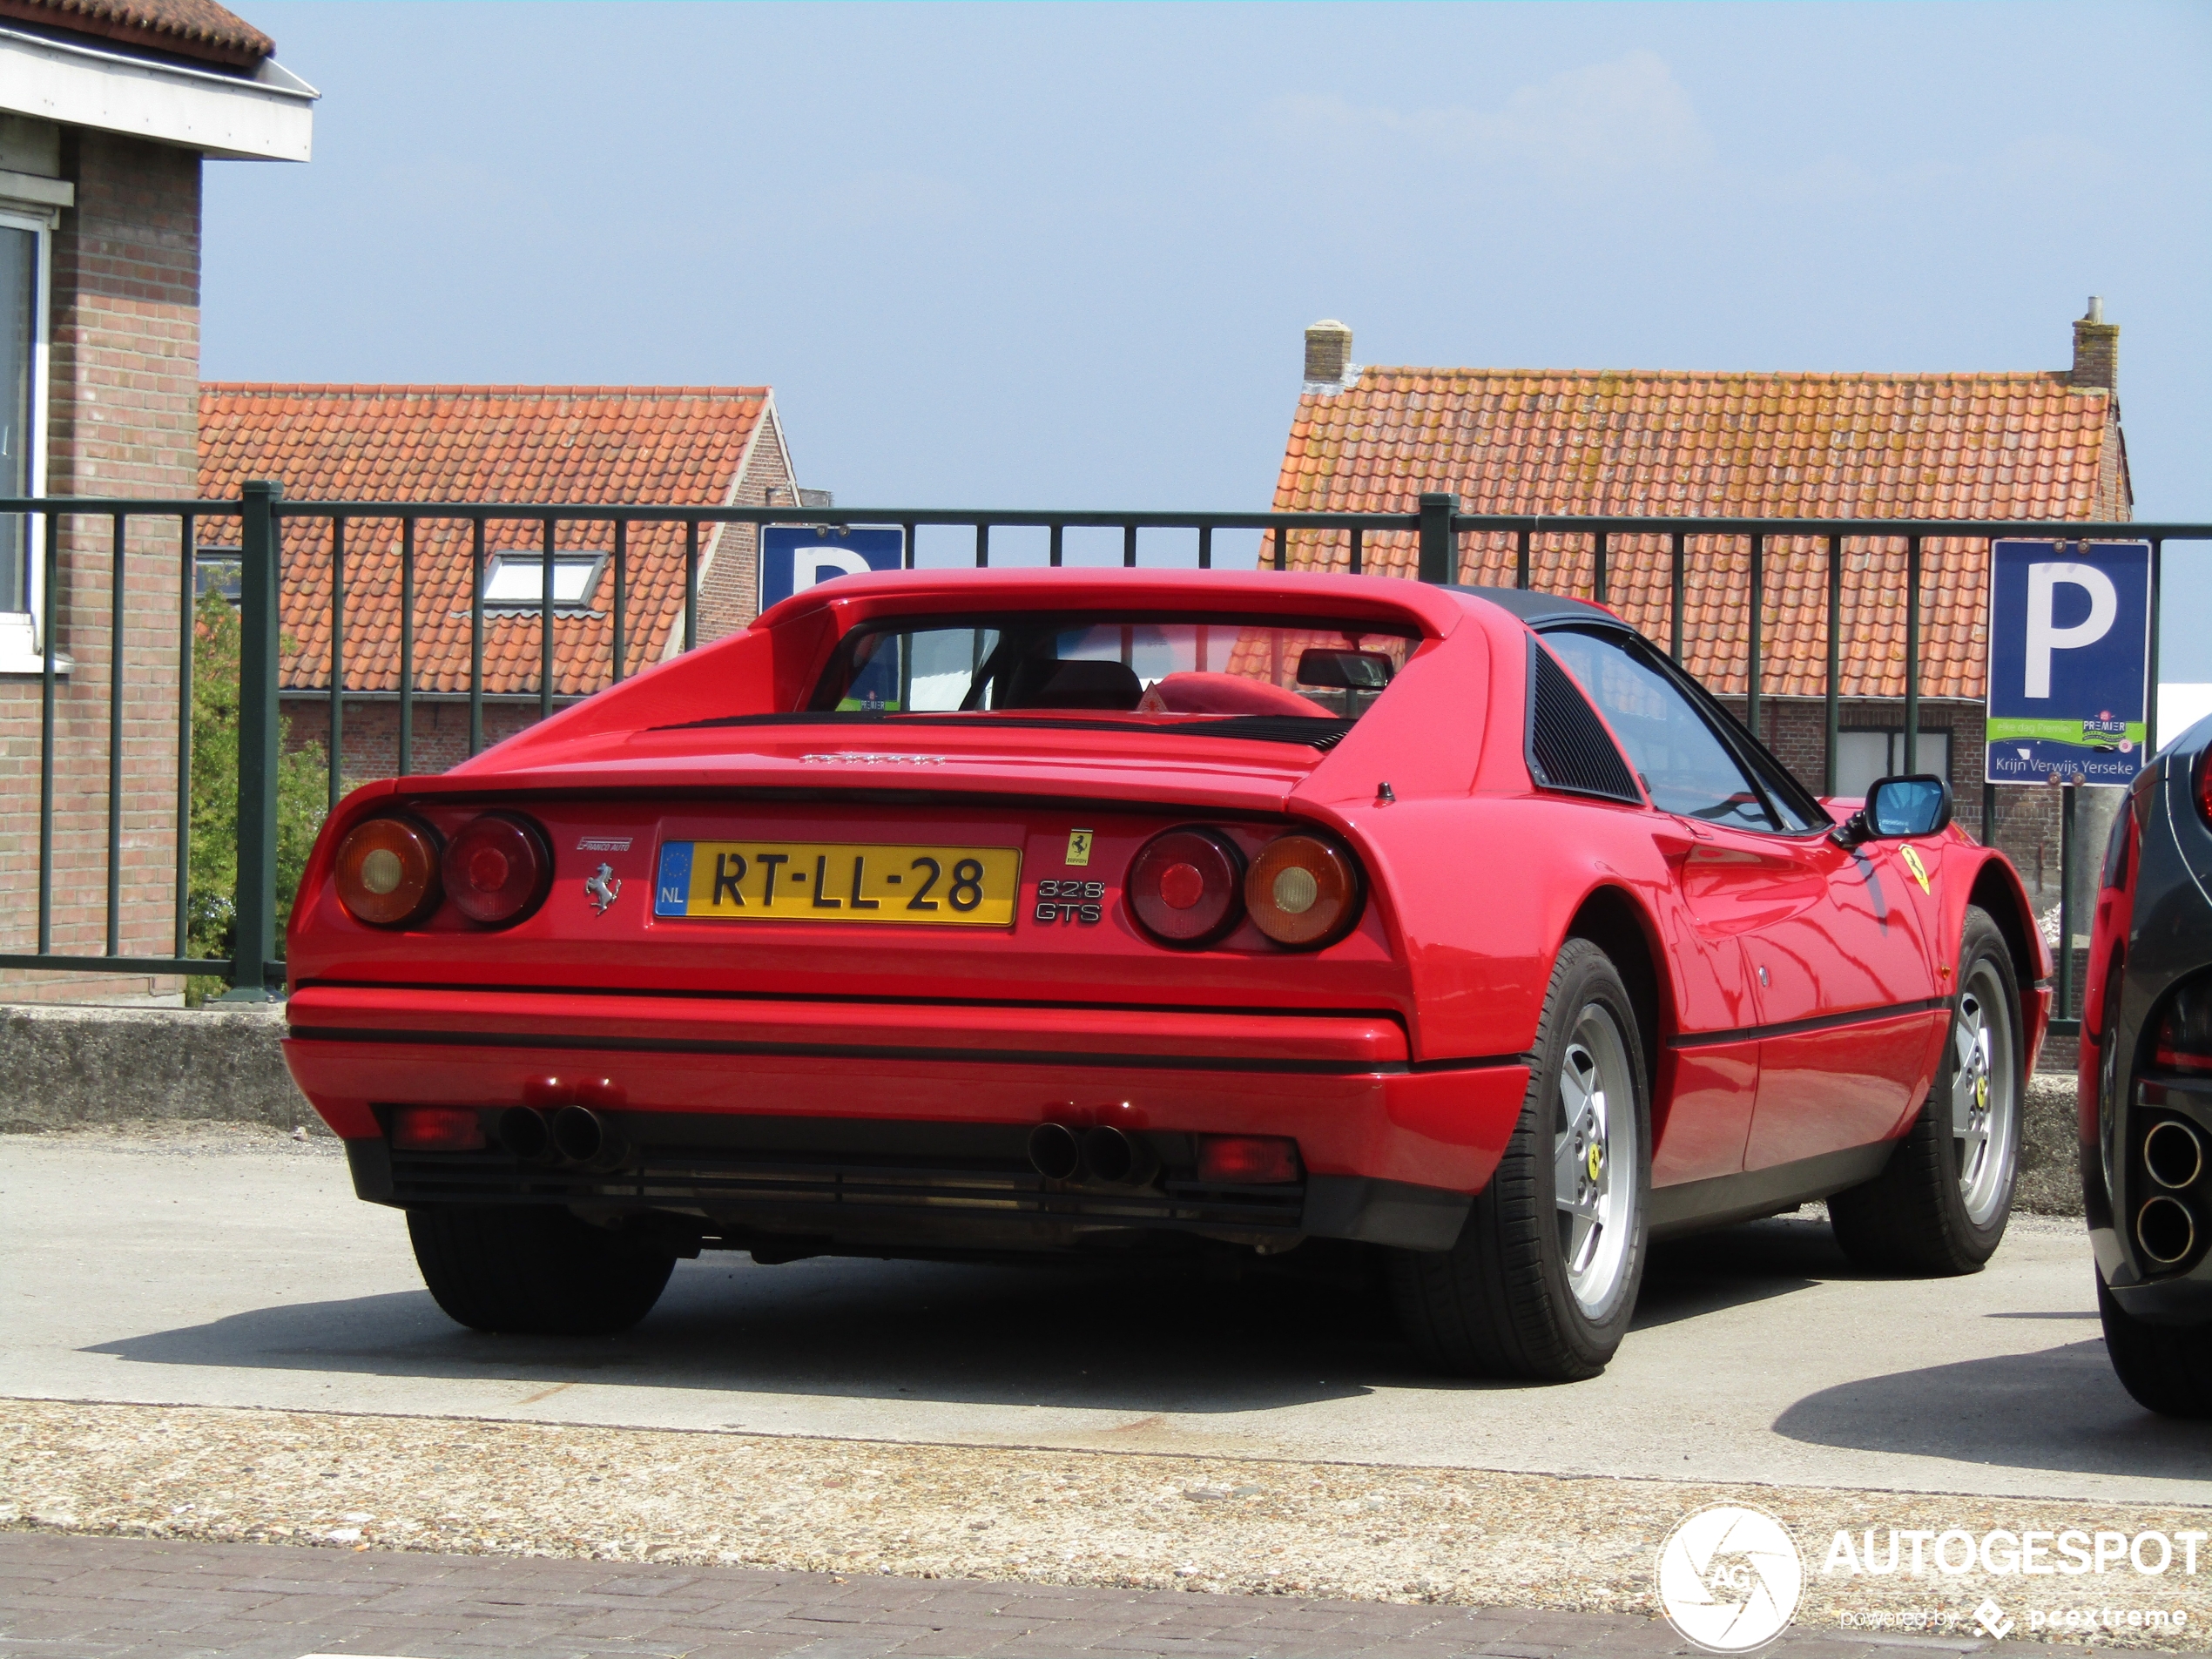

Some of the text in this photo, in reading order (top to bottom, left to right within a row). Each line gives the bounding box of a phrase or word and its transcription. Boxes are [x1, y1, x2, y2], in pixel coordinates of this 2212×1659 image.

[2025, 563, 2117, 698] P
[2018, 724, 2035, 734] dag
[2083, 720, 2125, 732] PREMIER
[1996, 758, 2133, 776] Krijn Verwijs Yerseke
[712, 853, 985, 912] RT-LL-28
[1039, 880, 1104, 899] 328
[661, 887, 684, 903] NL
[1036, 902, 1103, 921] GTS
